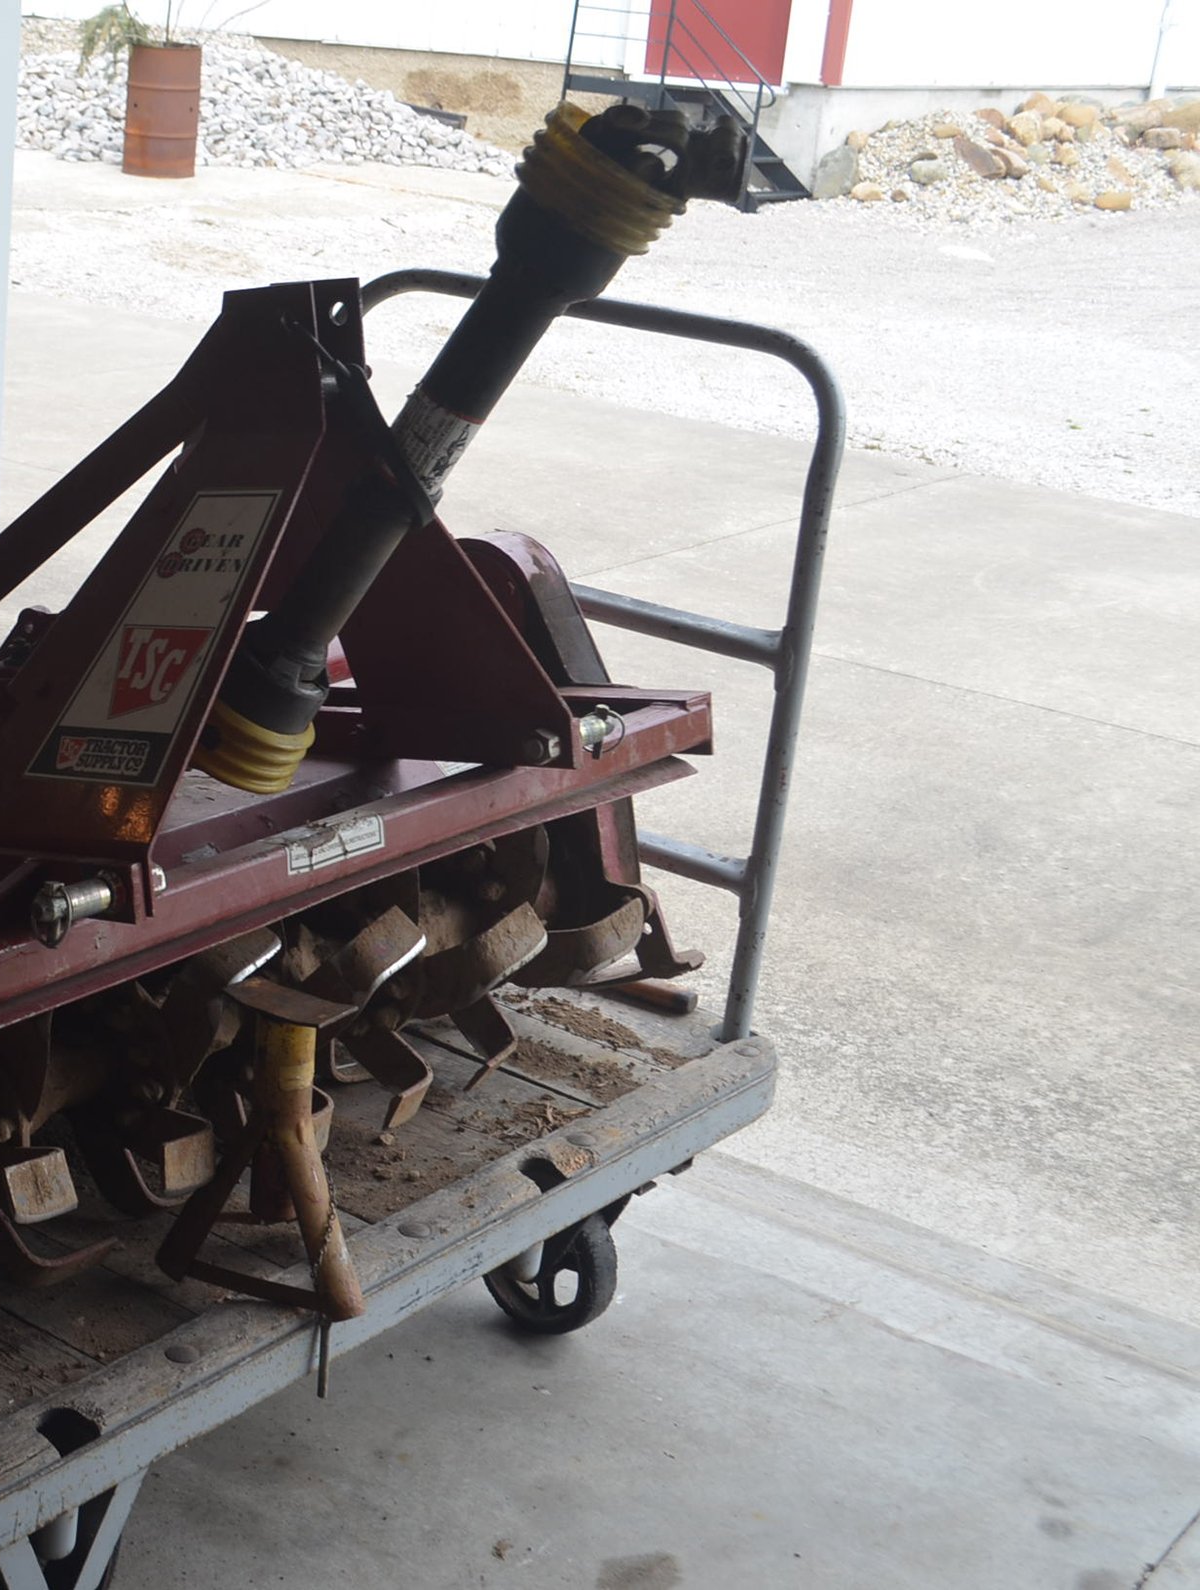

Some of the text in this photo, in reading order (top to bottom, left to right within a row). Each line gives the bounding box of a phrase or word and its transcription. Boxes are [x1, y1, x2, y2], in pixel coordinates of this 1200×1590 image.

[180, 530, 245, 551] GEAR
[158, 554, 246, 575] DRIVEN
[118, 628, 186, 702] TSC
[84, 739, 147, 756] TRACTOR
[75, 754, 125, 770] SUPPLY
